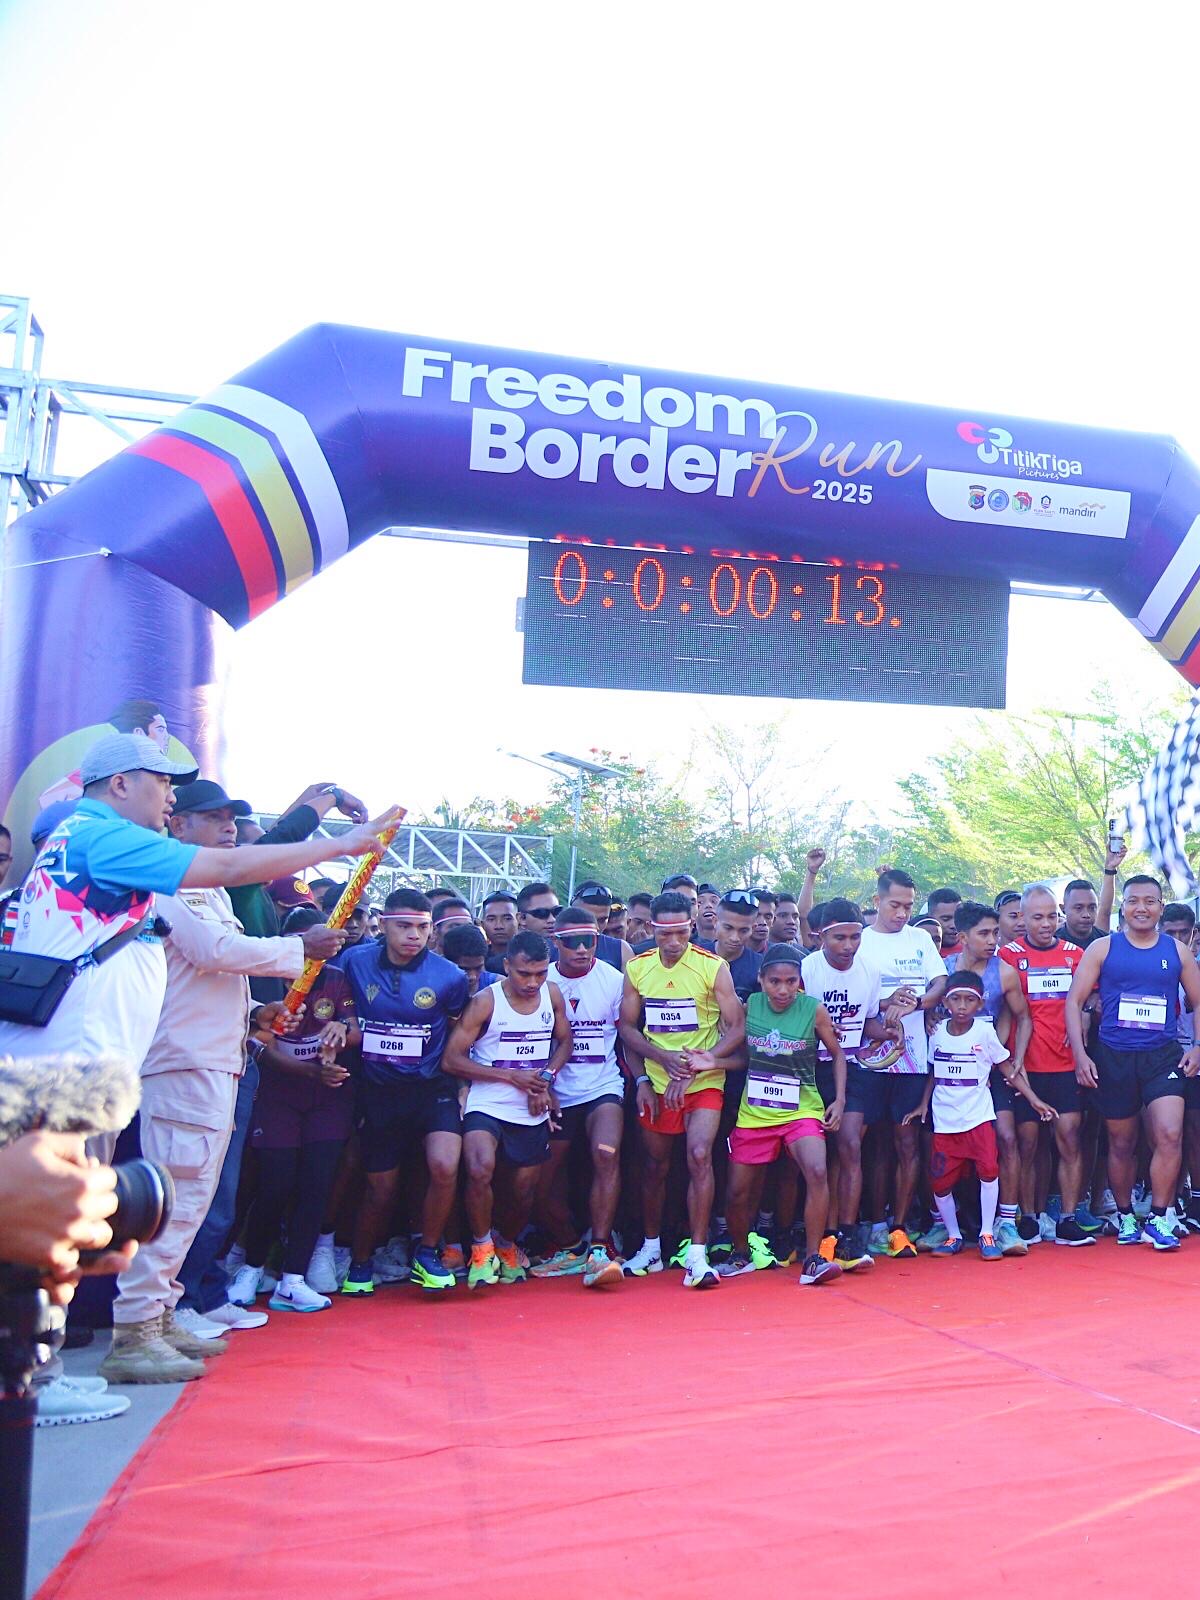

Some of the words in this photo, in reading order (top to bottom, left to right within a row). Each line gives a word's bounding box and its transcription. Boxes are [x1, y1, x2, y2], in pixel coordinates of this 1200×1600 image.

[402, 347, 778, 438] Freedom
[469, 407, 757, 498] Border
[747, 411, 922, 498] Run
[999, 447, 1083, 478] TitikTiga
[1018, 467, 1060, 480] Pictures
[812, 479, 874, 505] 2025
[1058, 505, 1097, 519] mandiri
[1042, 980, 1059, 988] 0641
[822, 989, 848, 1002] Wini
[824, 1002, 861, 1014] order
[1135, 1008, 1150, 1016] 1011
[660, 1012, 681, 1021] 0354
[380, 1040, 404, 1051] 0268
[516, 1046, 535, 1055] 1254
[947, 1065, 962, 1074] 1277
[764, 1086, 783, 1096] 0991
